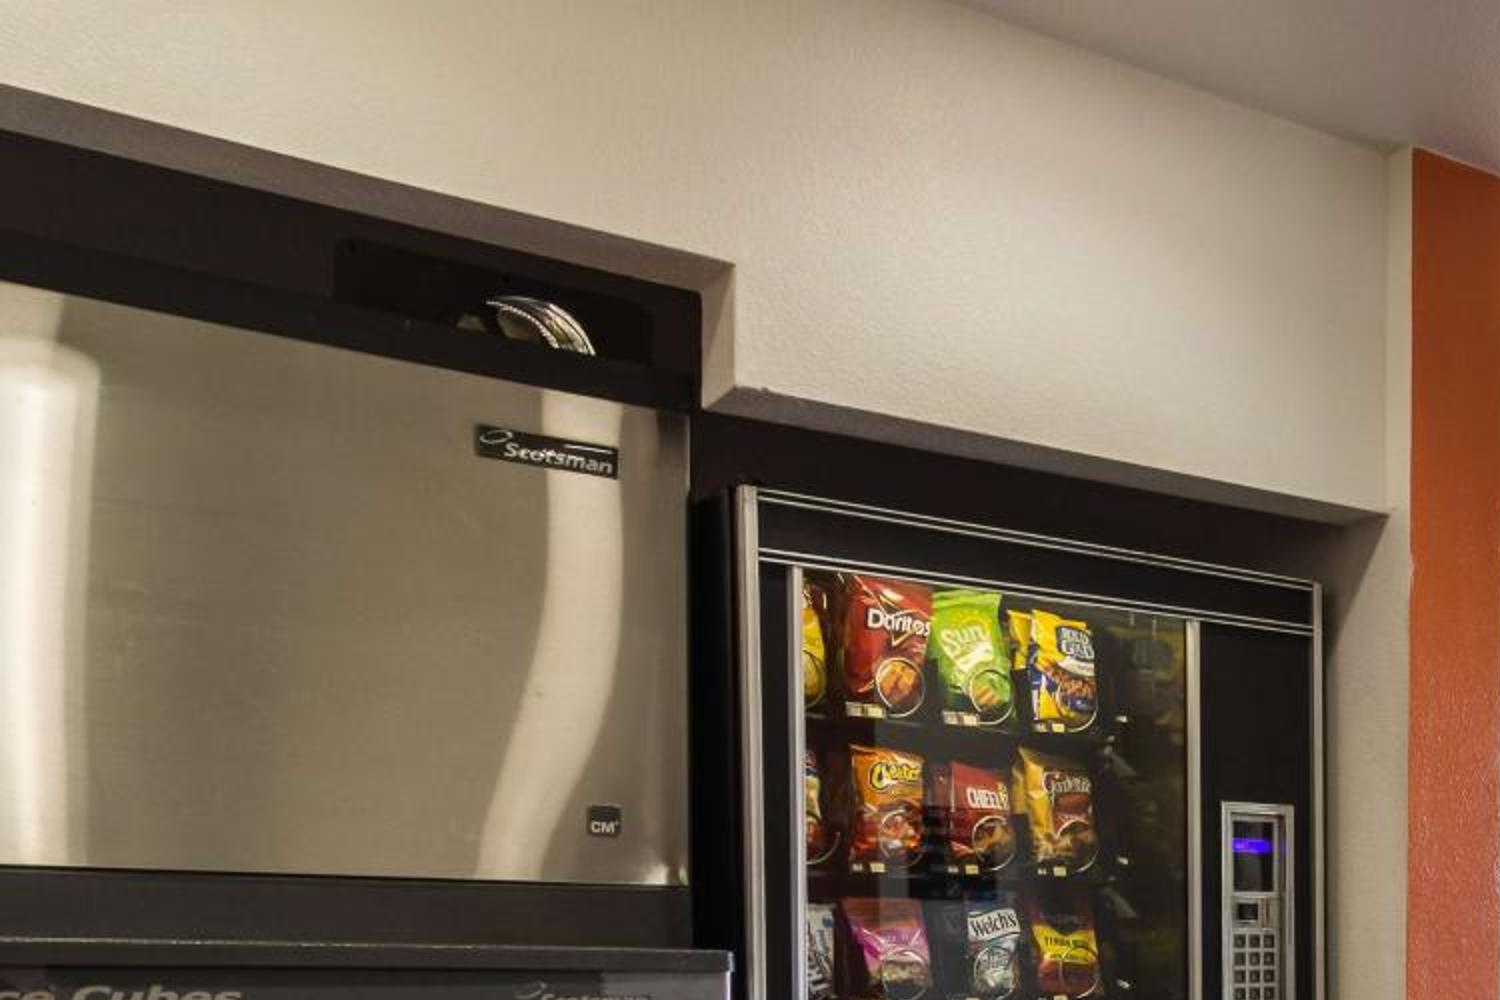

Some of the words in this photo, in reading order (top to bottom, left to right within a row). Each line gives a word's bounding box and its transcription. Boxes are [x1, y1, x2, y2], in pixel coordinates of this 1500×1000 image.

[503, 441, 613, 474] Scotsman
[867, 607, 932, 637] Doritos
[941, 625, 985, 659] Sun
